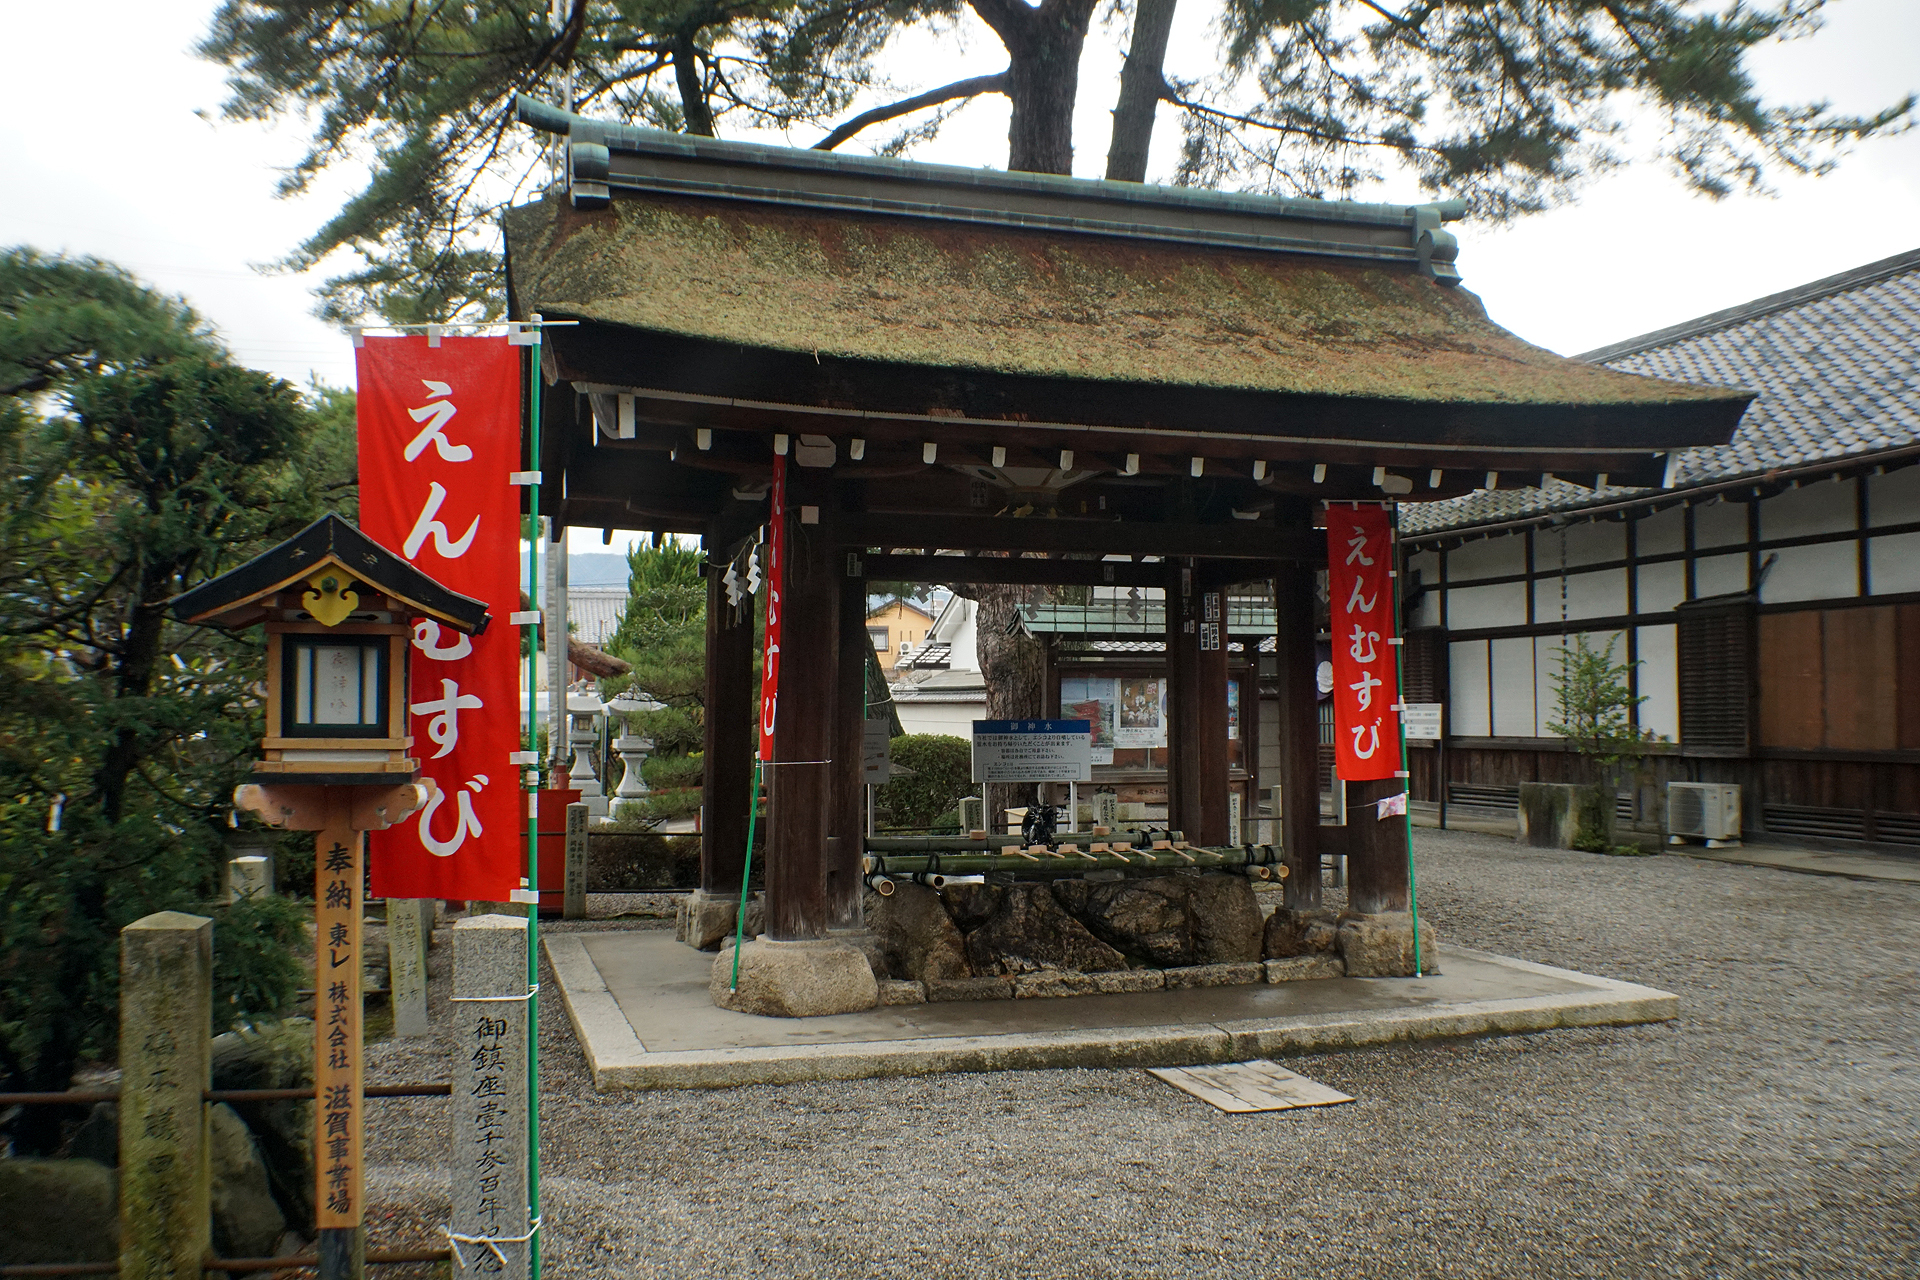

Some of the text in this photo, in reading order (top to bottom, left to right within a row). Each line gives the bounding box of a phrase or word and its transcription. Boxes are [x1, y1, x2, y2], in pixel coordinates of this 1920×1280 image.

[403, 379, 490, 857] えんむすび
[764, 467, 781, 737] むすび
[1010, 722, 1053, 731] 御神水
[1345, 526, 1383, 760] えんむすび
[323, 842, 354, 1215] 奉納 東レ 株式会社 滋賀事業場
